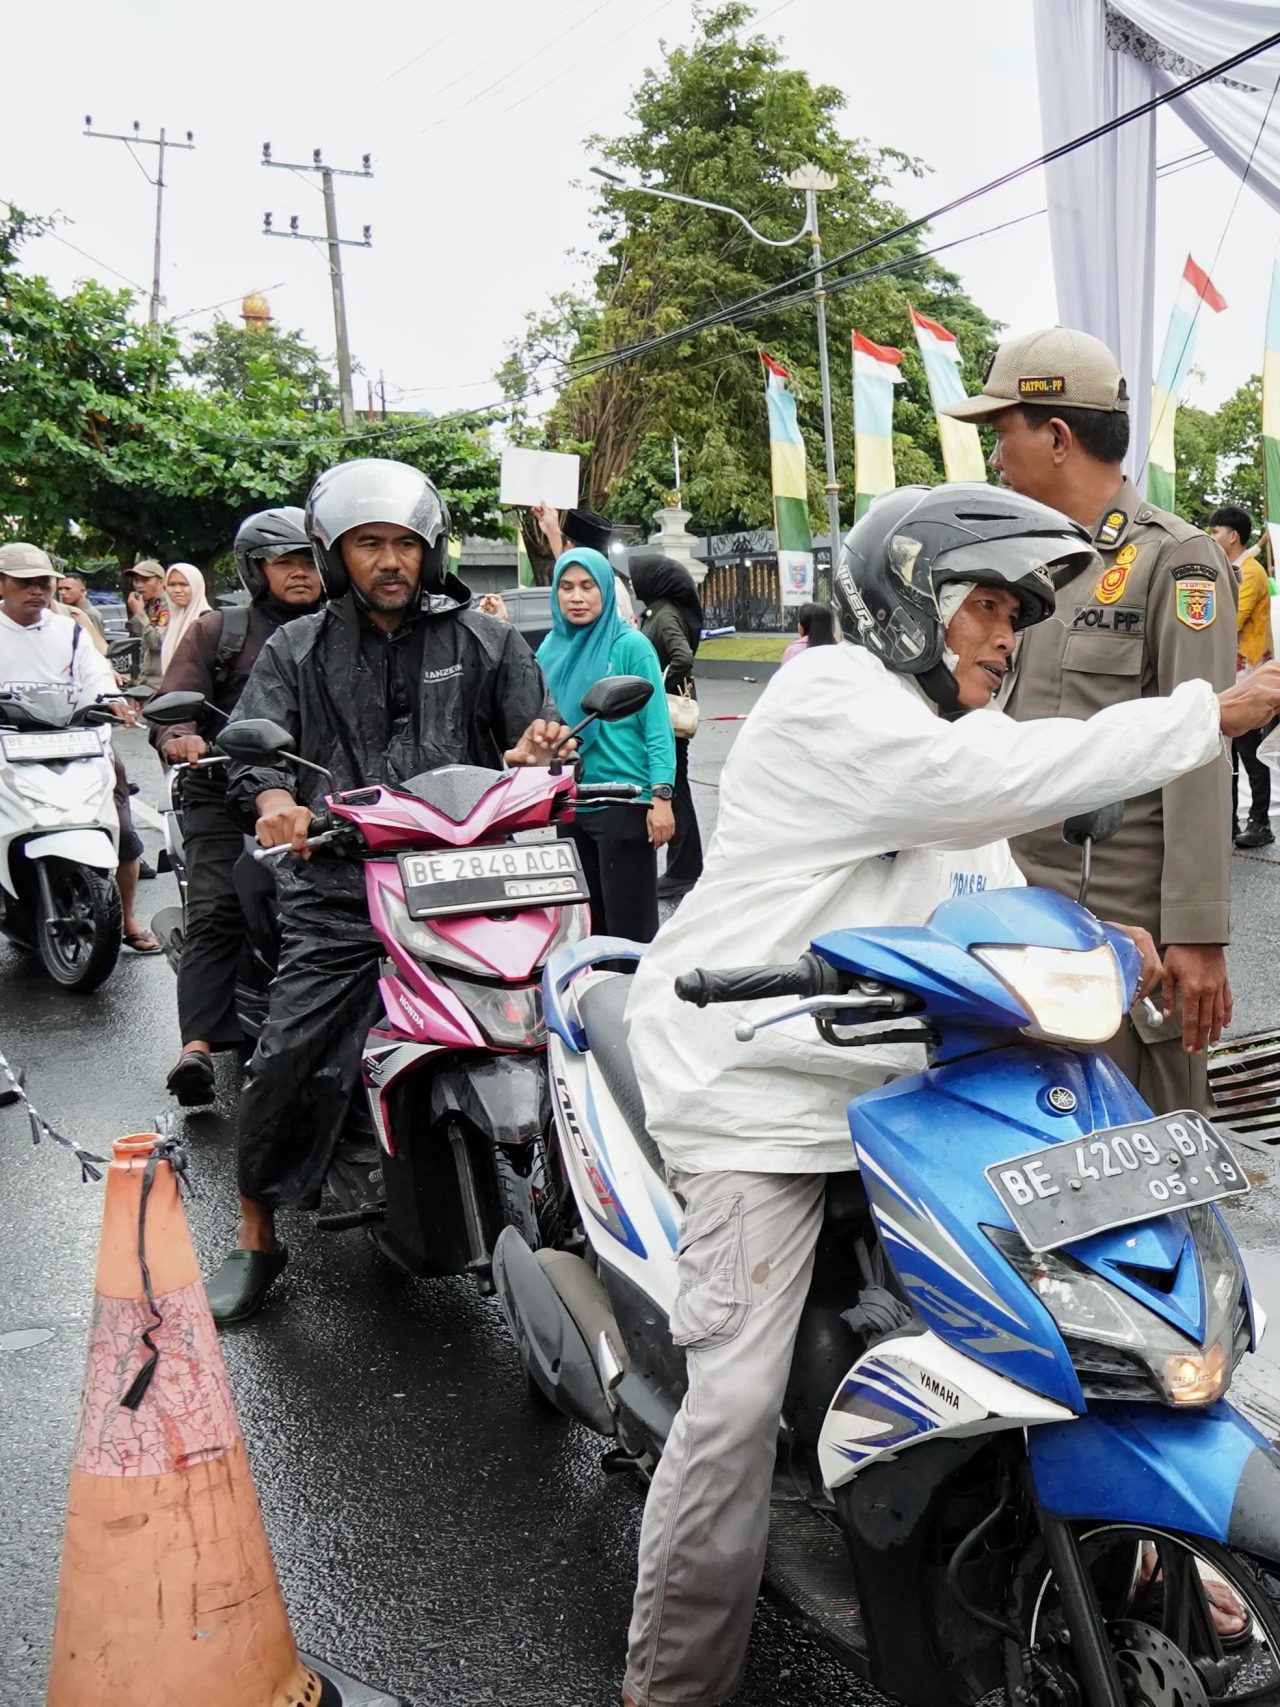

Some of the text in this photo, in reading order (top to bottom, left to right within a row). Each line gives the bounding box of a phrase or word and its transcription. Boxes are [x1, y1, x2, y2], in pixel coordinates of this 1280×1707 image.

[1020, 380, 1062, 391] SATPOL-PP
[1073, 608, 1140, 630] POL PP
[413, 848, 572, 884] BE 2848 ACA
[1000, 1117, 1219, 1206] BE 4209 BX
[920, 1371, 960, 1410] YAMAHA
